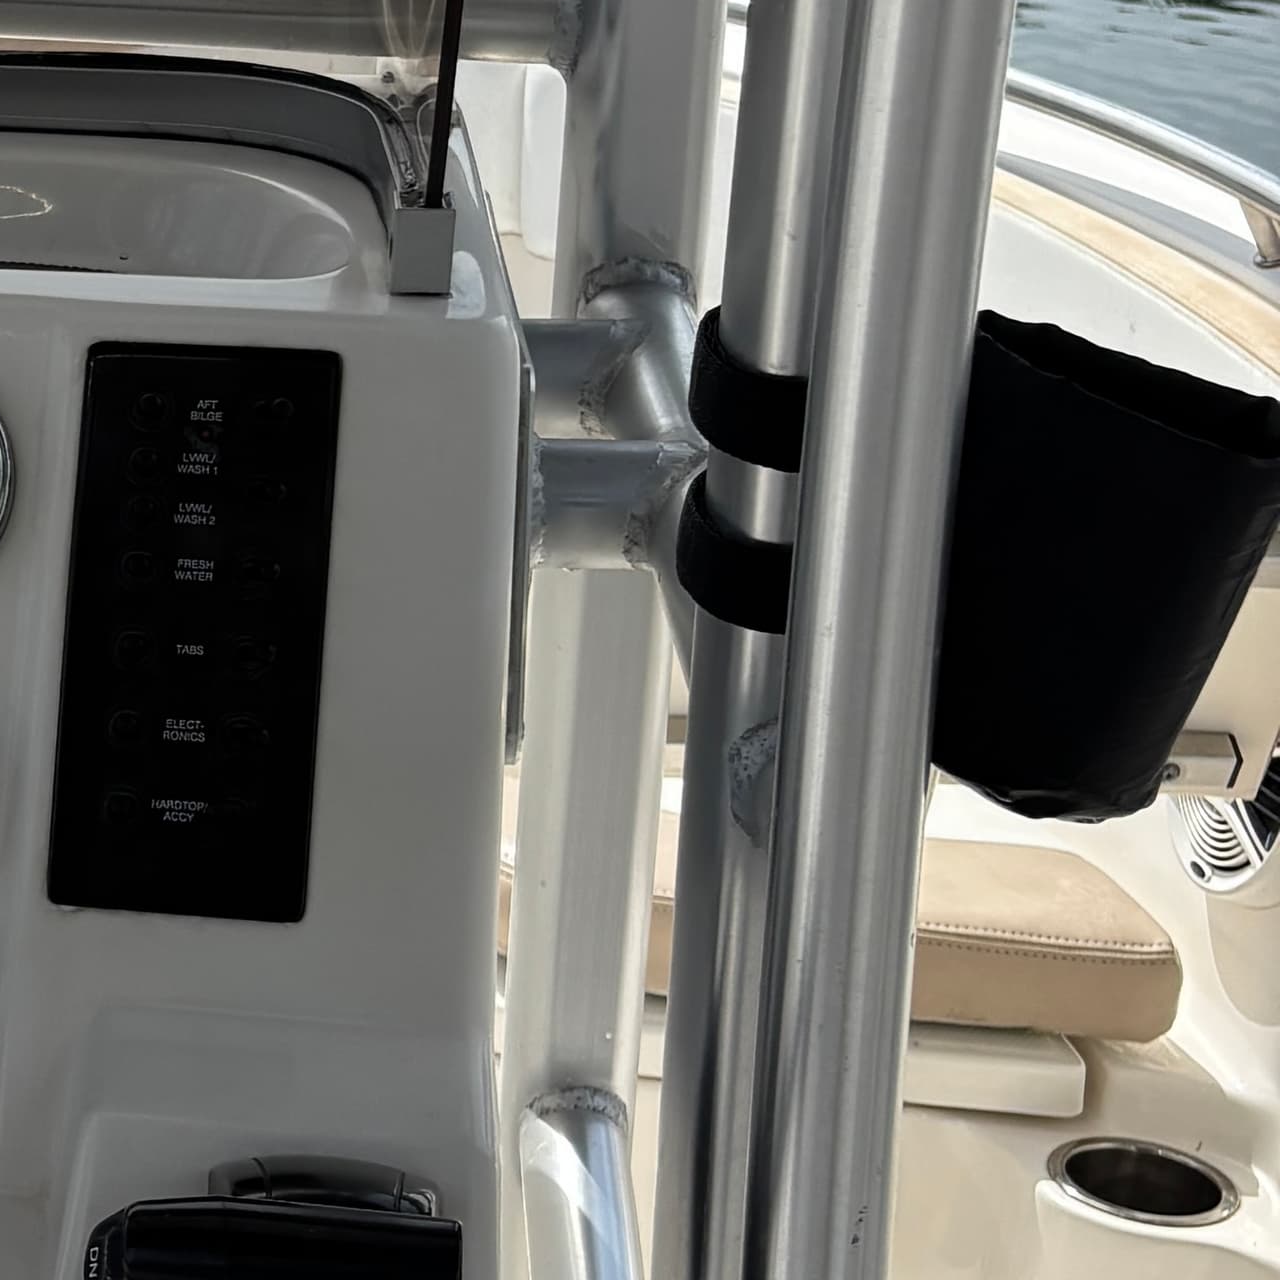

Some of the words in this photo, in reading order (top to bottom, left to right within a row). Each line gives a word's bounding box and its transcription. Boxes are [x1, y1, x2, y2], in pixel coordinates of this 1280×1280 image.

[197, 400, 218, 409] AFT
[190, 410, 223, 421] BILGE
[177, 464, 210, 475] WASH
[174, 514, 206, 525] WASH
[209, 516, 216, 526] 2
[177, 559, 214, 569] FRESH
[174, 570, 213, 581] WATER
[176, 644, 204, 655] TABS
[163, 730, 205, 742] RONICS
